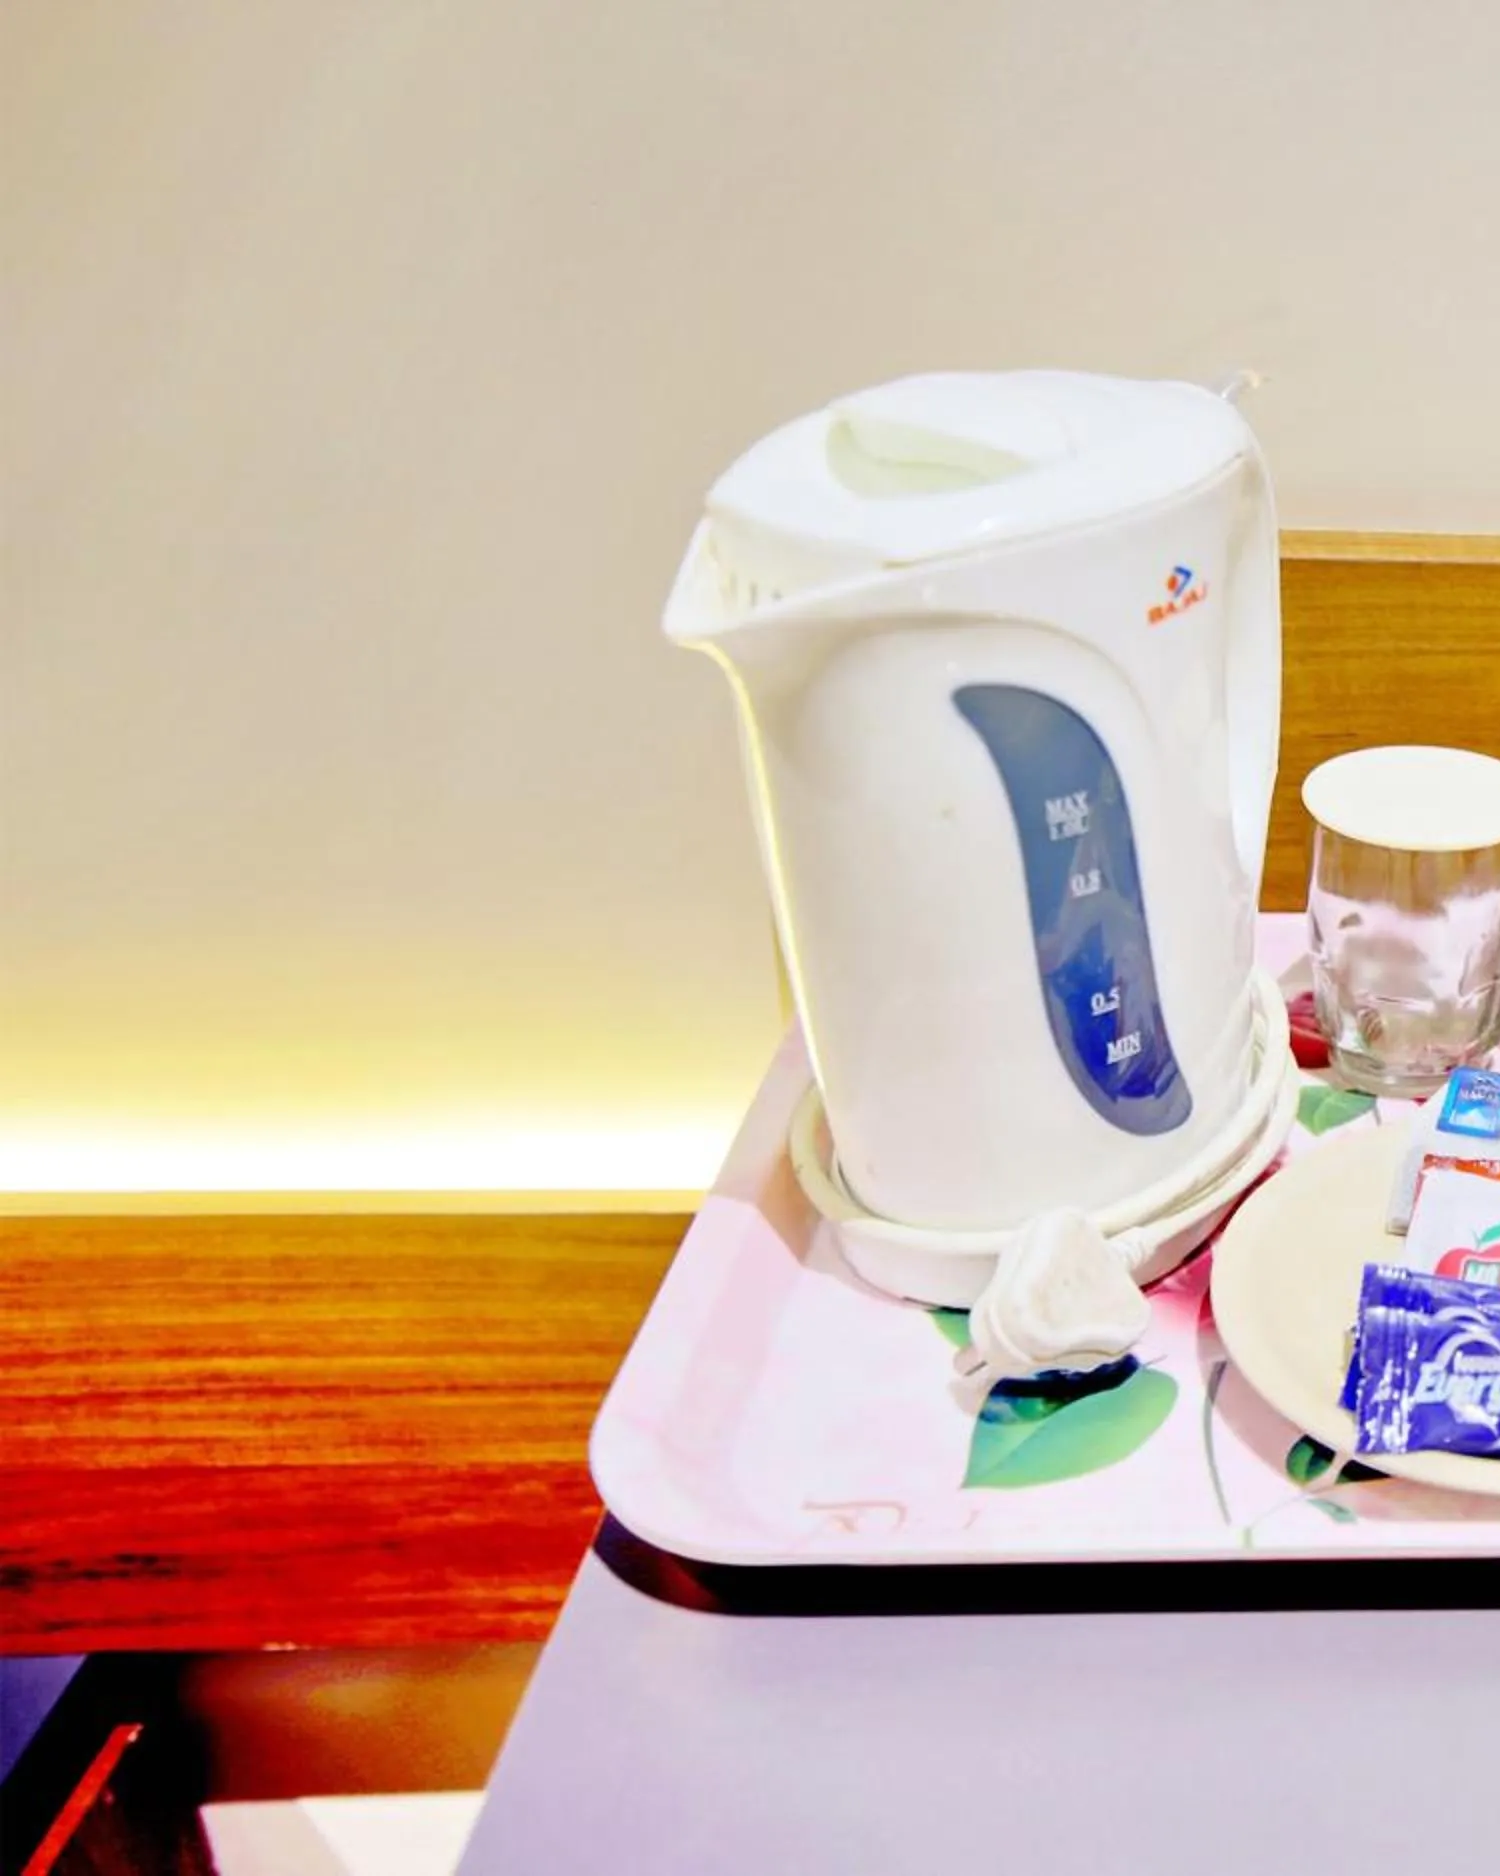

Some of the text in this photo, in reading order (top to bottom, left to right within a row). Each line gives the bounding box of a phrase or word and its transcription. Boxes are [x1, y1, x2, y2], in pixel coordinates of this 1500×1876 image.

[1044, 790, 1089, 824] MAX
[1091, 986, 1121, 1015] 0.5
[1106, 1032, 1141, 1064] MIN
